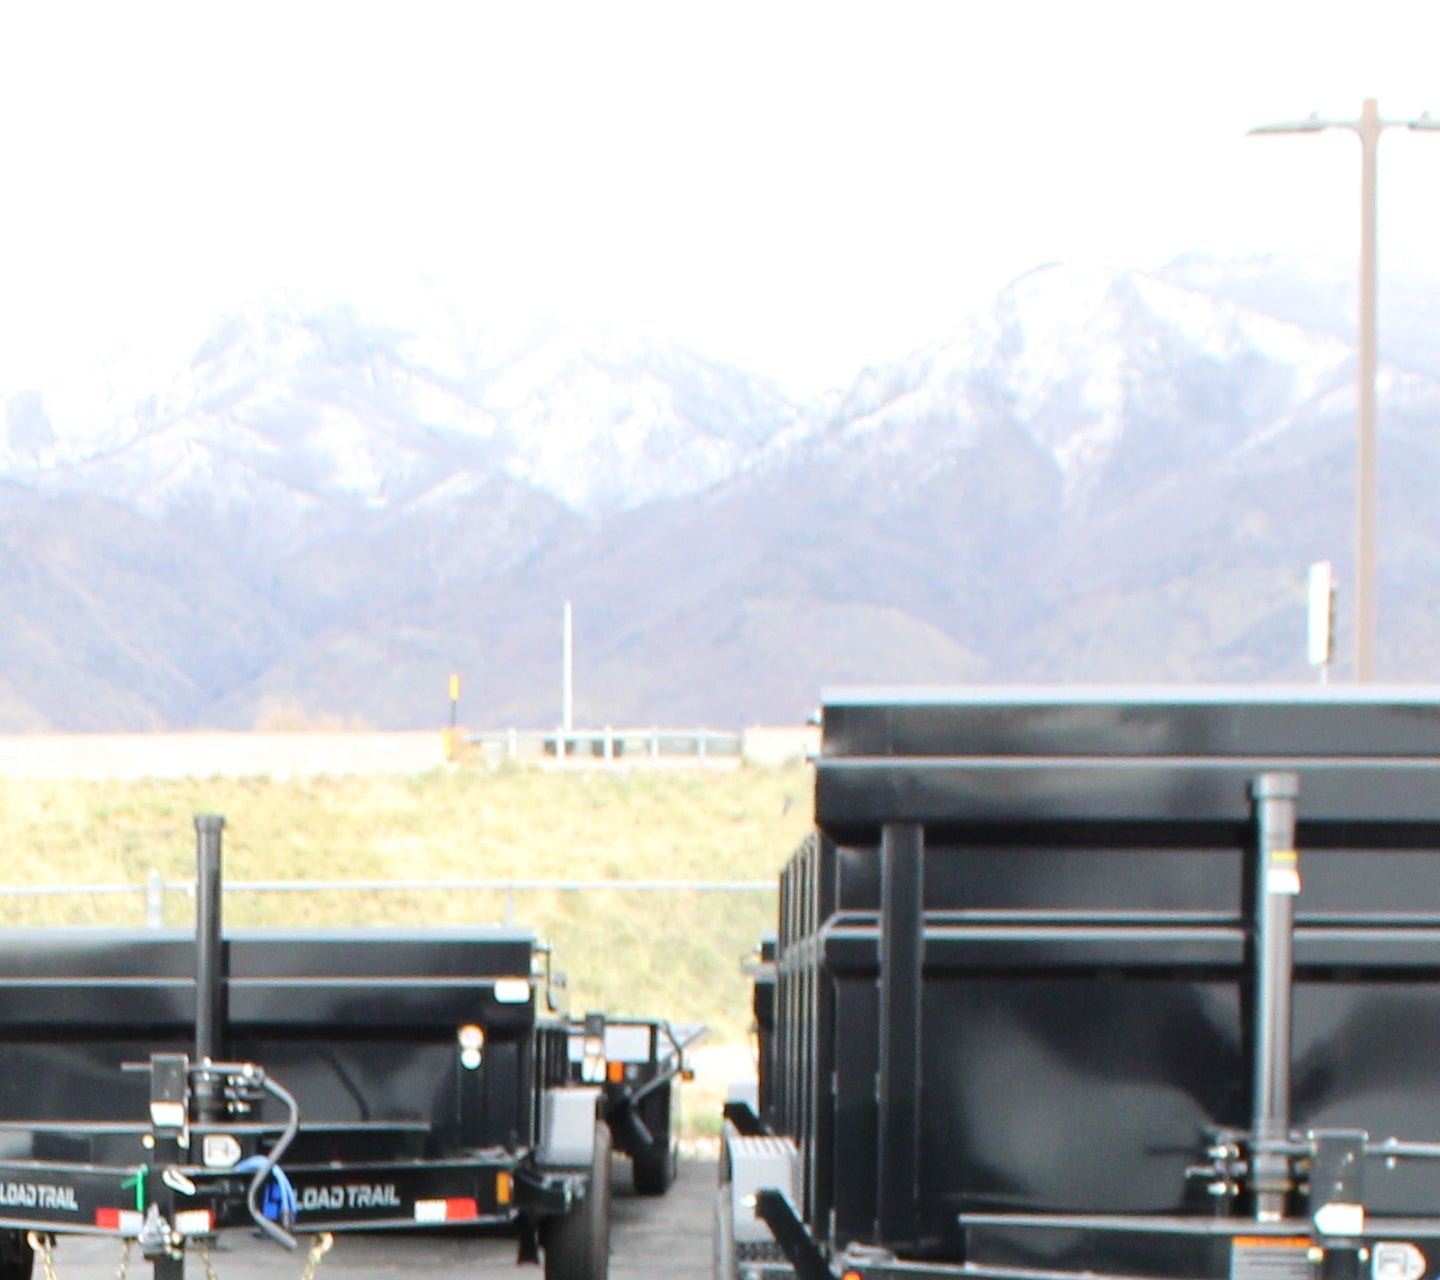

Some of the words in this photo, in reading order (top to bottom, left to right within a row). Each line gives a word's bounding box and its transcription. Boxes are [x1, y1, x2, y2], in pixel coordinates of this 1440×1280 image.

[0, 1184, 36, 1205] LOAD
[35, 1187, 78, 1210] TRAIL
[345, 1183, 400, 1205] TRAIL
